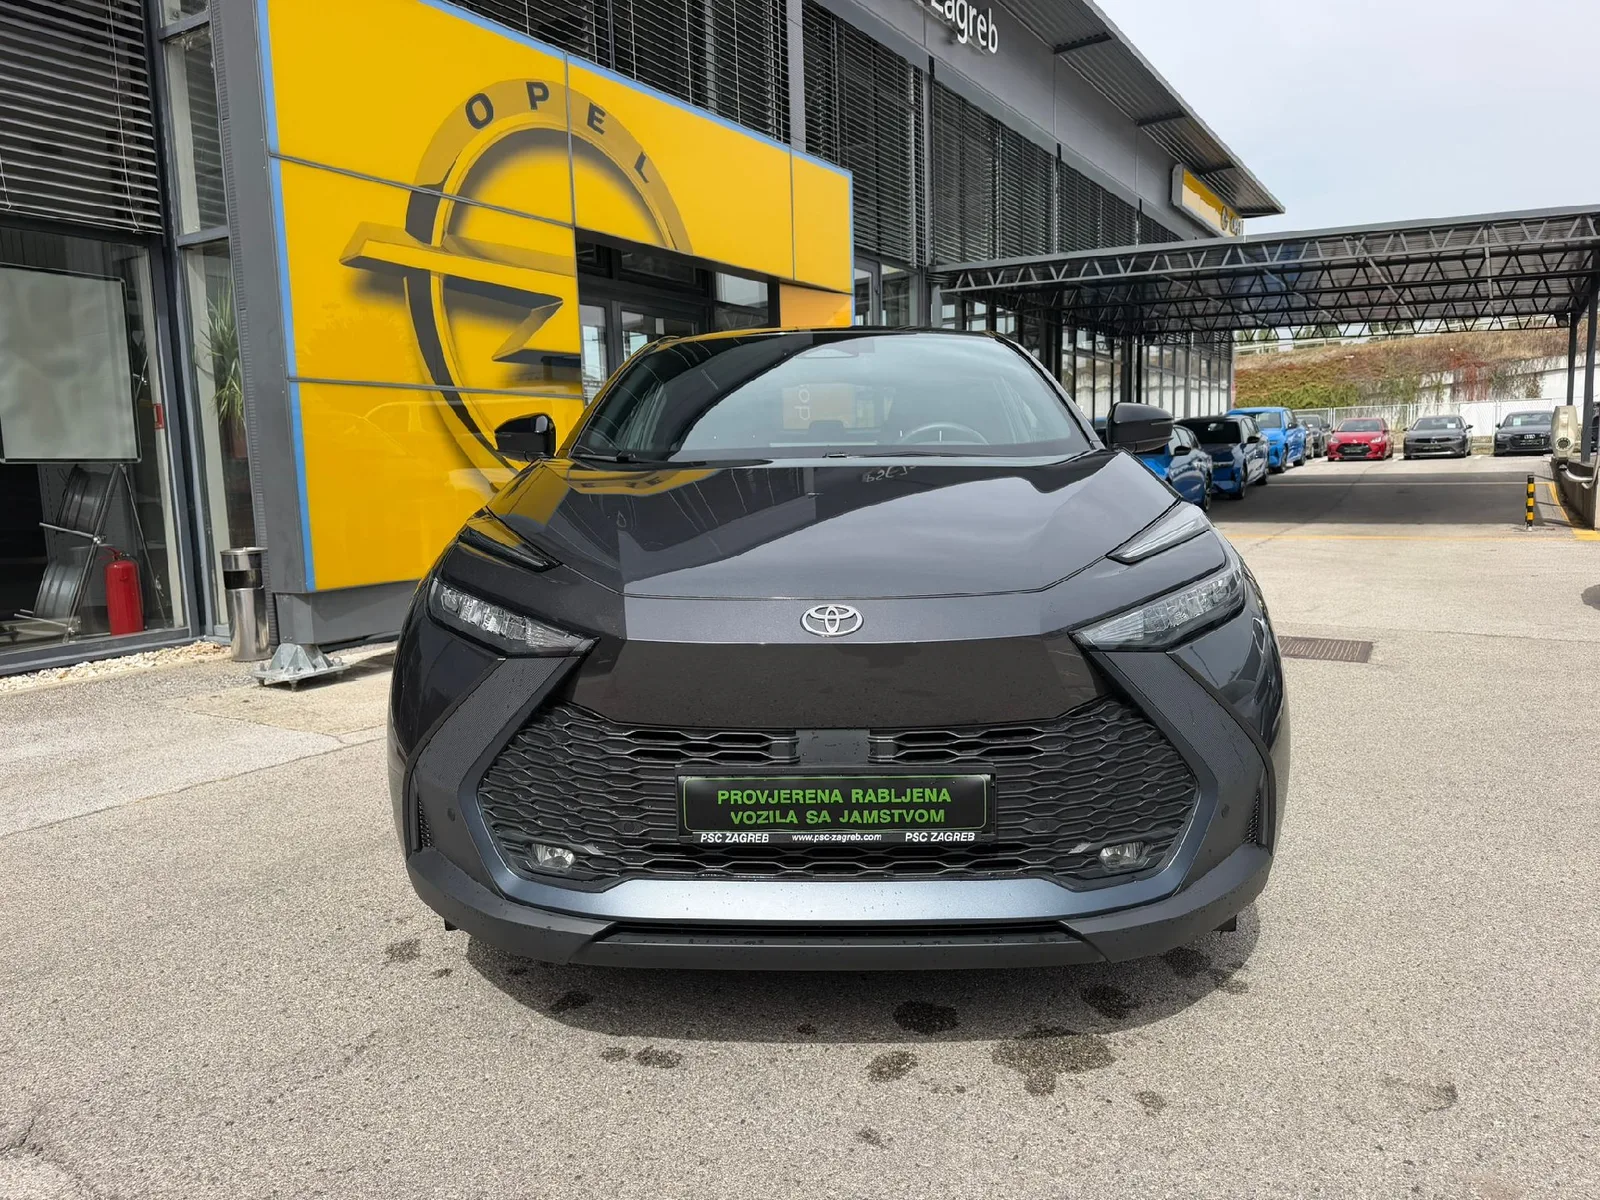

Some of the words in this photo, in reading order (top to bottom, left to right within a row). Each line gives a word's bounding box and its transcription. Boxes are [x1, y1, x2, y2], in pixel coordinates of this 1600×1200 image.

[465, 81, 649, 183] OPEL
[717, 789, 844, 805] PROVJERENA
[851, 788, 952, 803] RABLJENA
[730, 810, 799, 824] VOZILA
[805, 810, 832, 824] SA
[839, 809, 945, 824] JAMSTVOM
[700, 833, 723, 843] PSC
[725, 833, 770, 844] ZAGREB
[791, 833, 882, 843] www.psc-zagreb.com
[905, 832, 928, 843] PSC
[930, 832, 976, 842] ZAGREB
